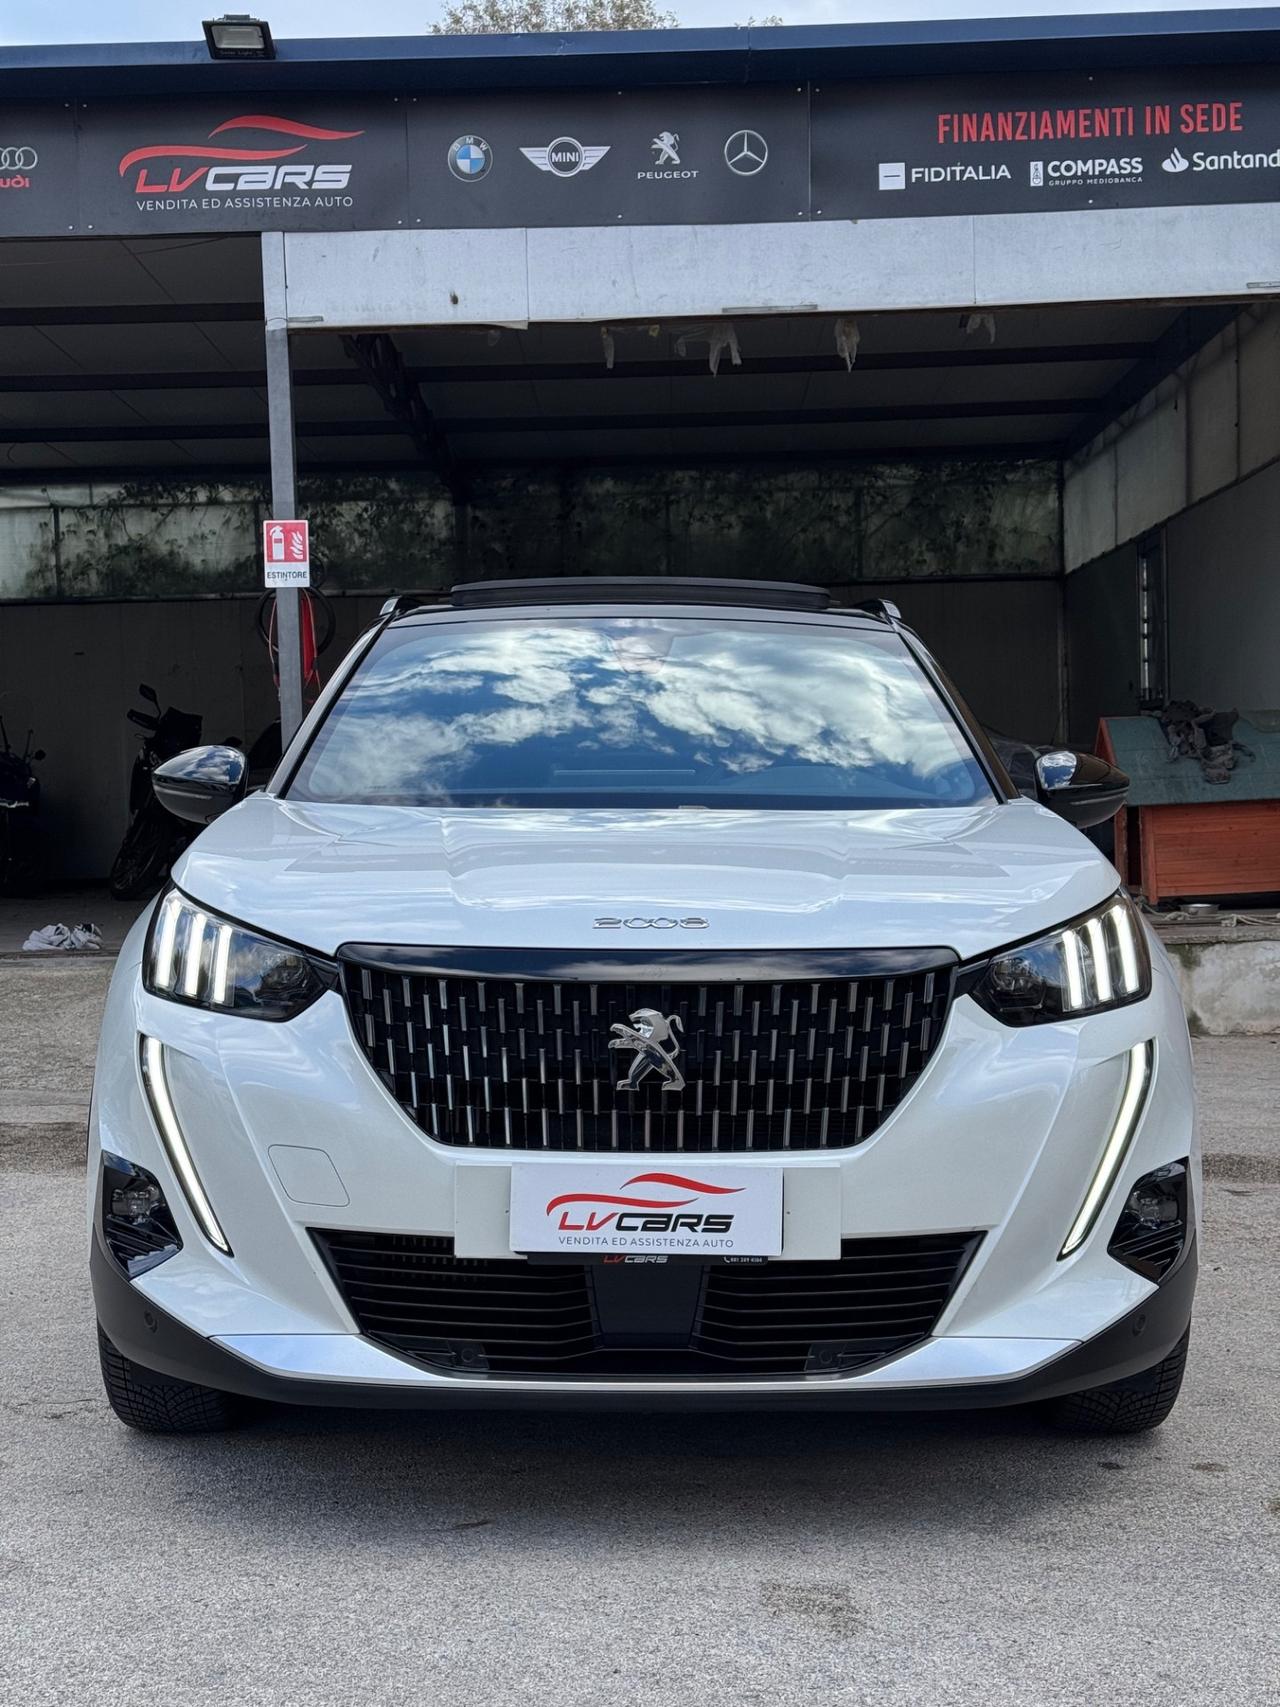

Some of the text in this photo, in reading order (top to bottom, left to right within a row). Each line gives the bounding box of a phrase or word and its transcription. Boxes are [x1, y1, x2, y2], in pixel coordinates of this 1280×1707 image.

[937, 102, 1244, 144] FINANZIAMENTI IN SEDE
[551, 152, 580, 164] MINI
[911, 164, 1012, 183] FIDITALIA
[1047, 157, 1144, 178] COMPASS
[636, 170, 700, 180] PEUGEOT
[1086, 176, 1143, 185] MEDIOBANCA
[136, 196, 354, 211] VENDITA ED ASSISTENZA AUTO
[266, 571, 308, 579] ESTINTORE
[592, 917, 710, 929] 2008
[558, 1236, 734, 1248] VENDITA ED ASSISTENZA AUTO
